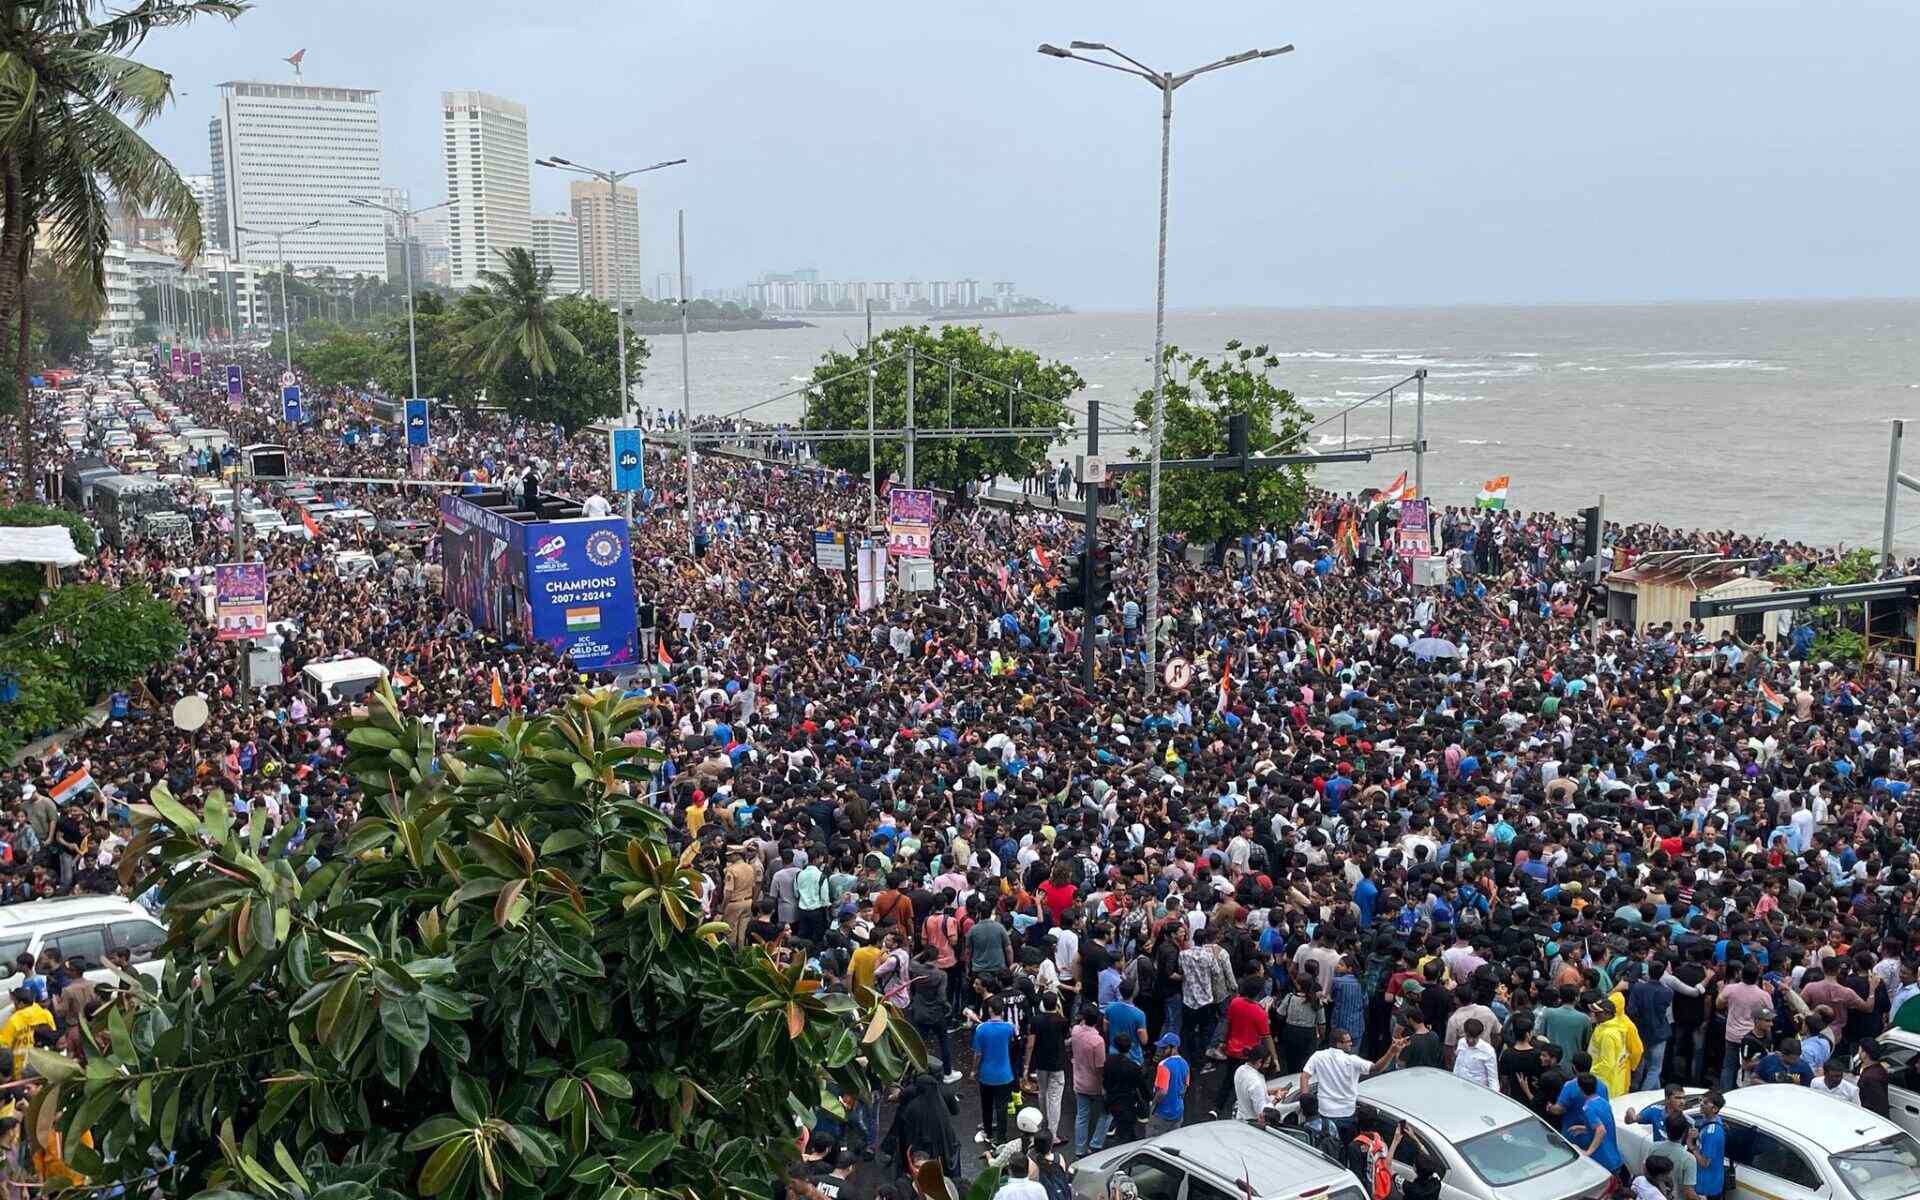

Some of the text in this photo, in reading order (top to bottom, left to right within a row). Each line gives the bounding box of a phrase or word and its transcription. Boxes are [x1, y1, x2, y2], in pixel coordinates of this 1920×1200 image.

[621, 454, 637, 464] Jio
[546, 576, 616, 593] CHAMPIONS
[552, 591, 605, 604] 2007 2024
[569, 645, 592, 655] ORLD
[593, 644, 609, 652] CUP
